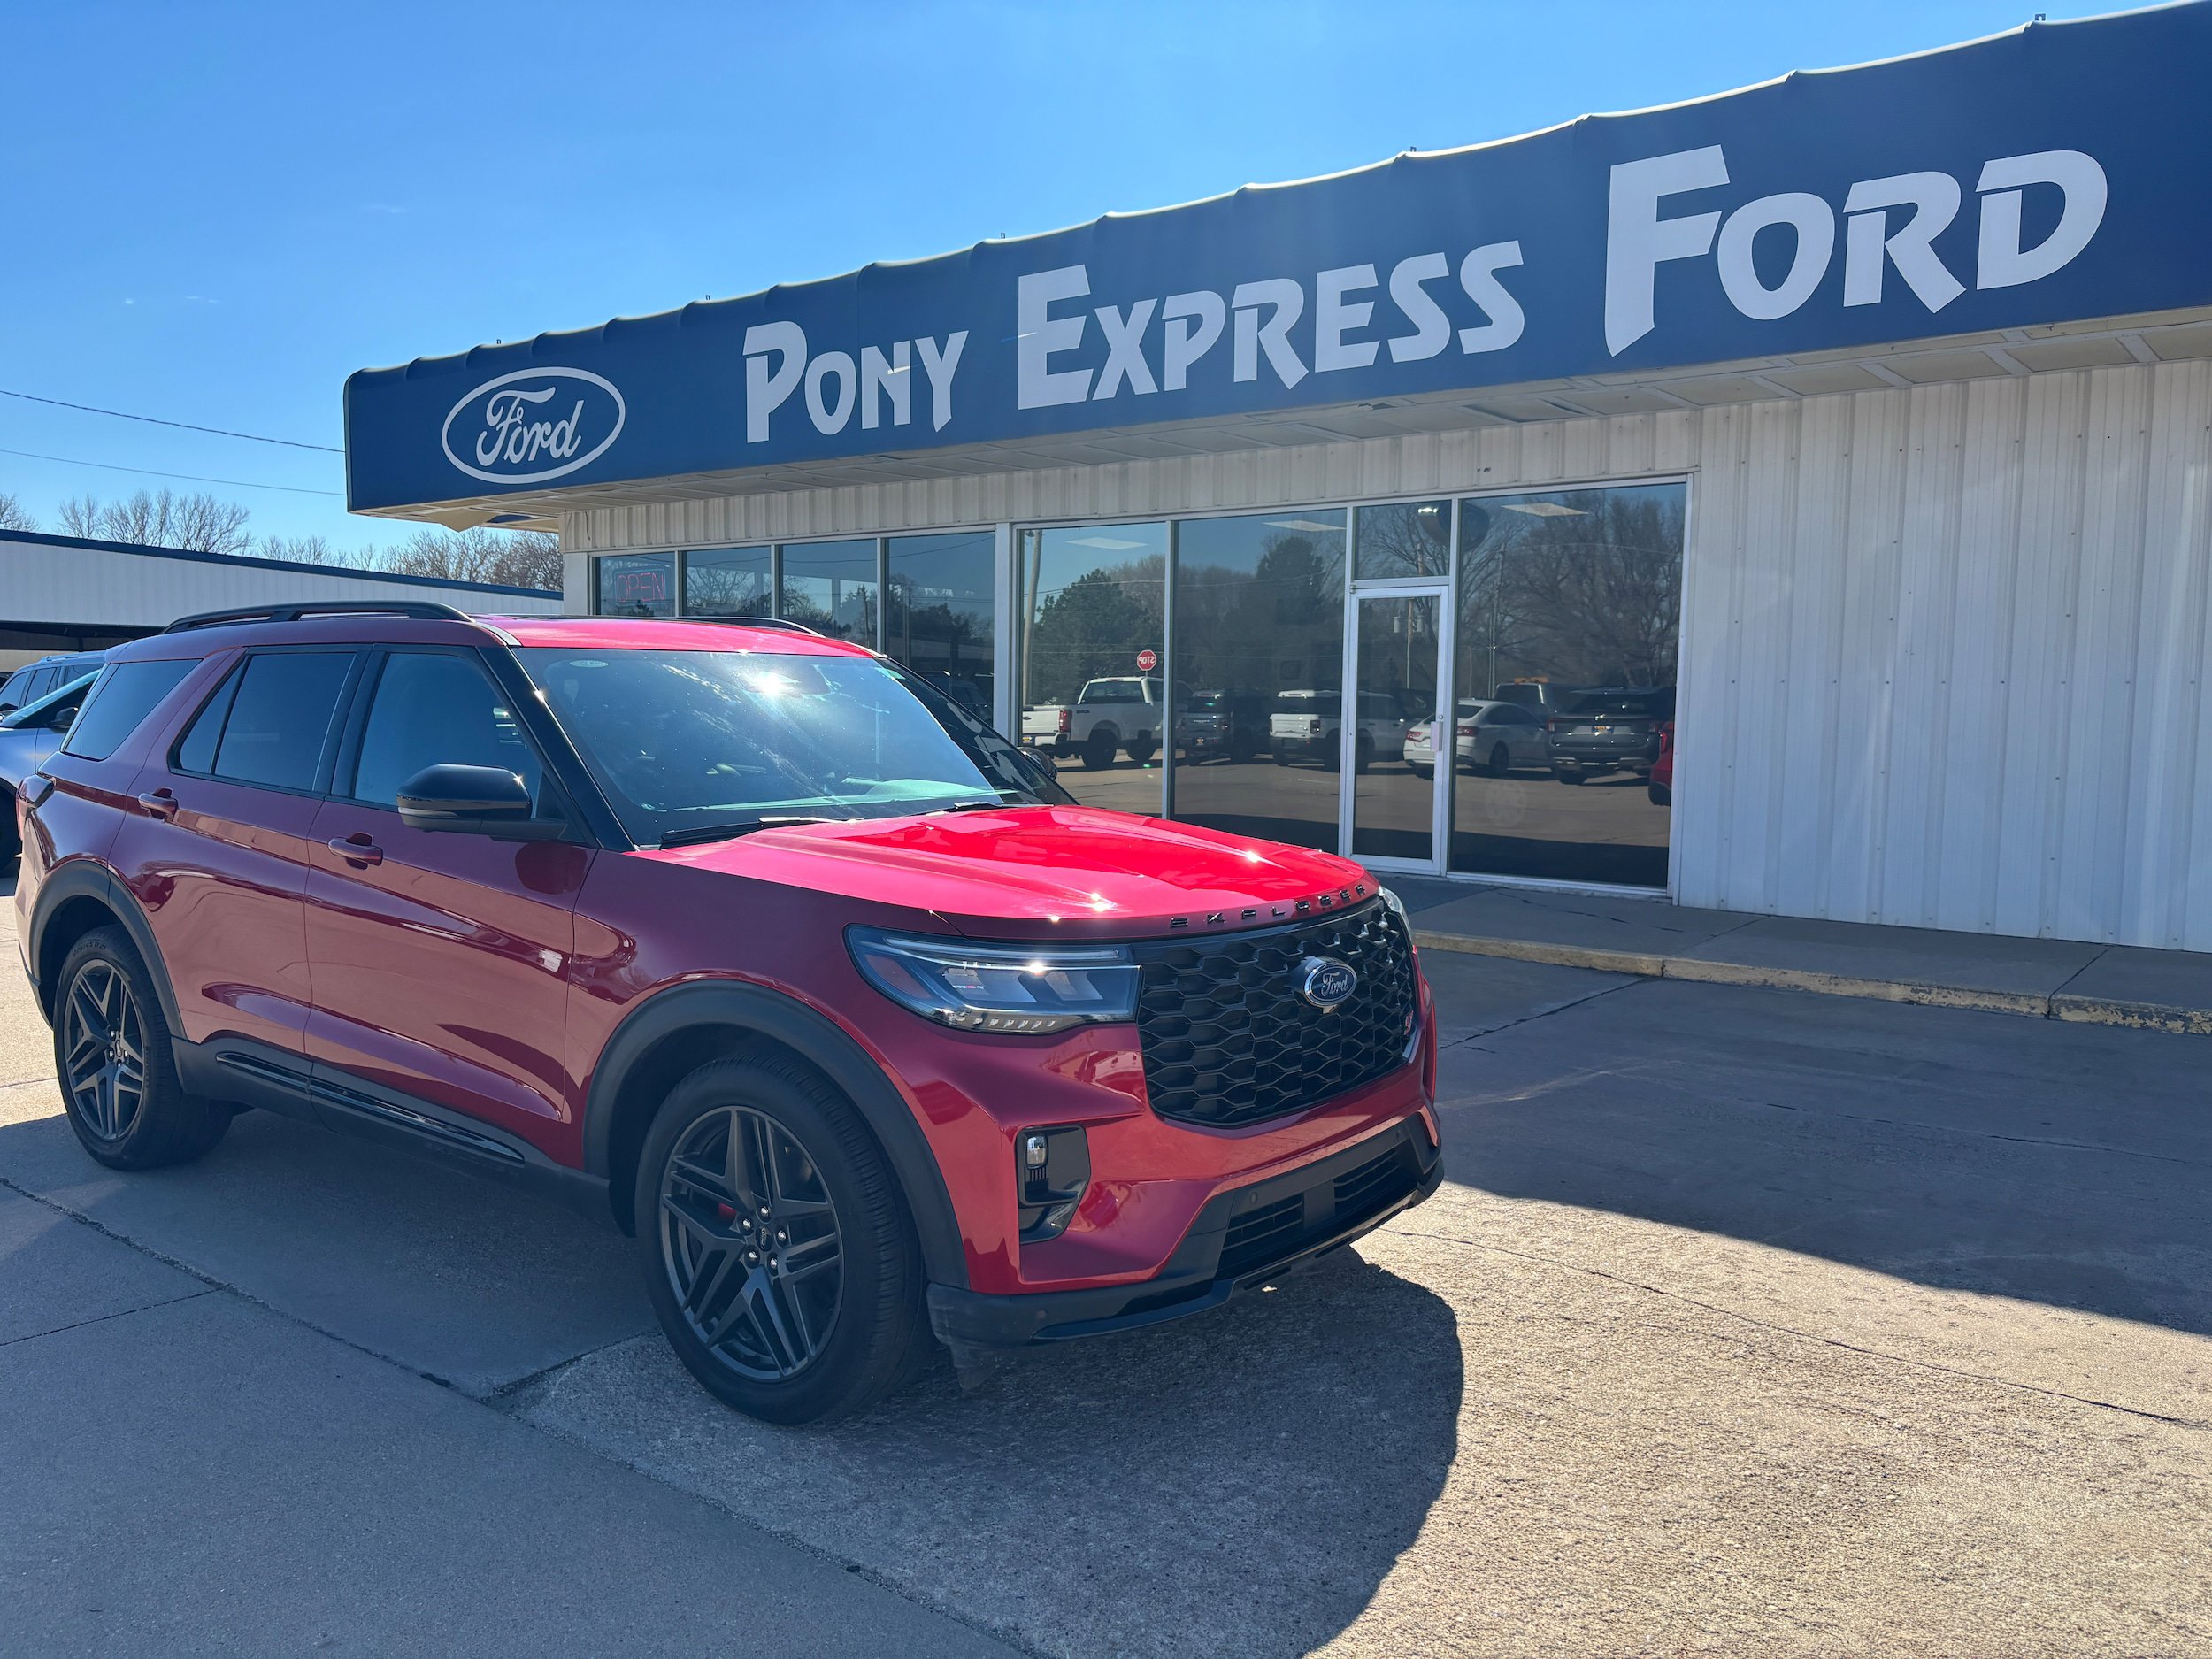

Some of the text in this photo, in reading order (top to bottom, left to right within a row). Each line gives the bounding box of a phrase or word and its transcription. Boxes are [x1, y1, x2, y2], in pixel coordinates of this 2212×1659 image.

[742, 144, 2108, 443] PONY EXPRESS FORD
[476, 387, 584, 467] Ford
[617, 572, 665, 603] OPEN
[1171, 884, 1365, 927] EXPLORER
[1321, 971, 1348, 997] Ford
